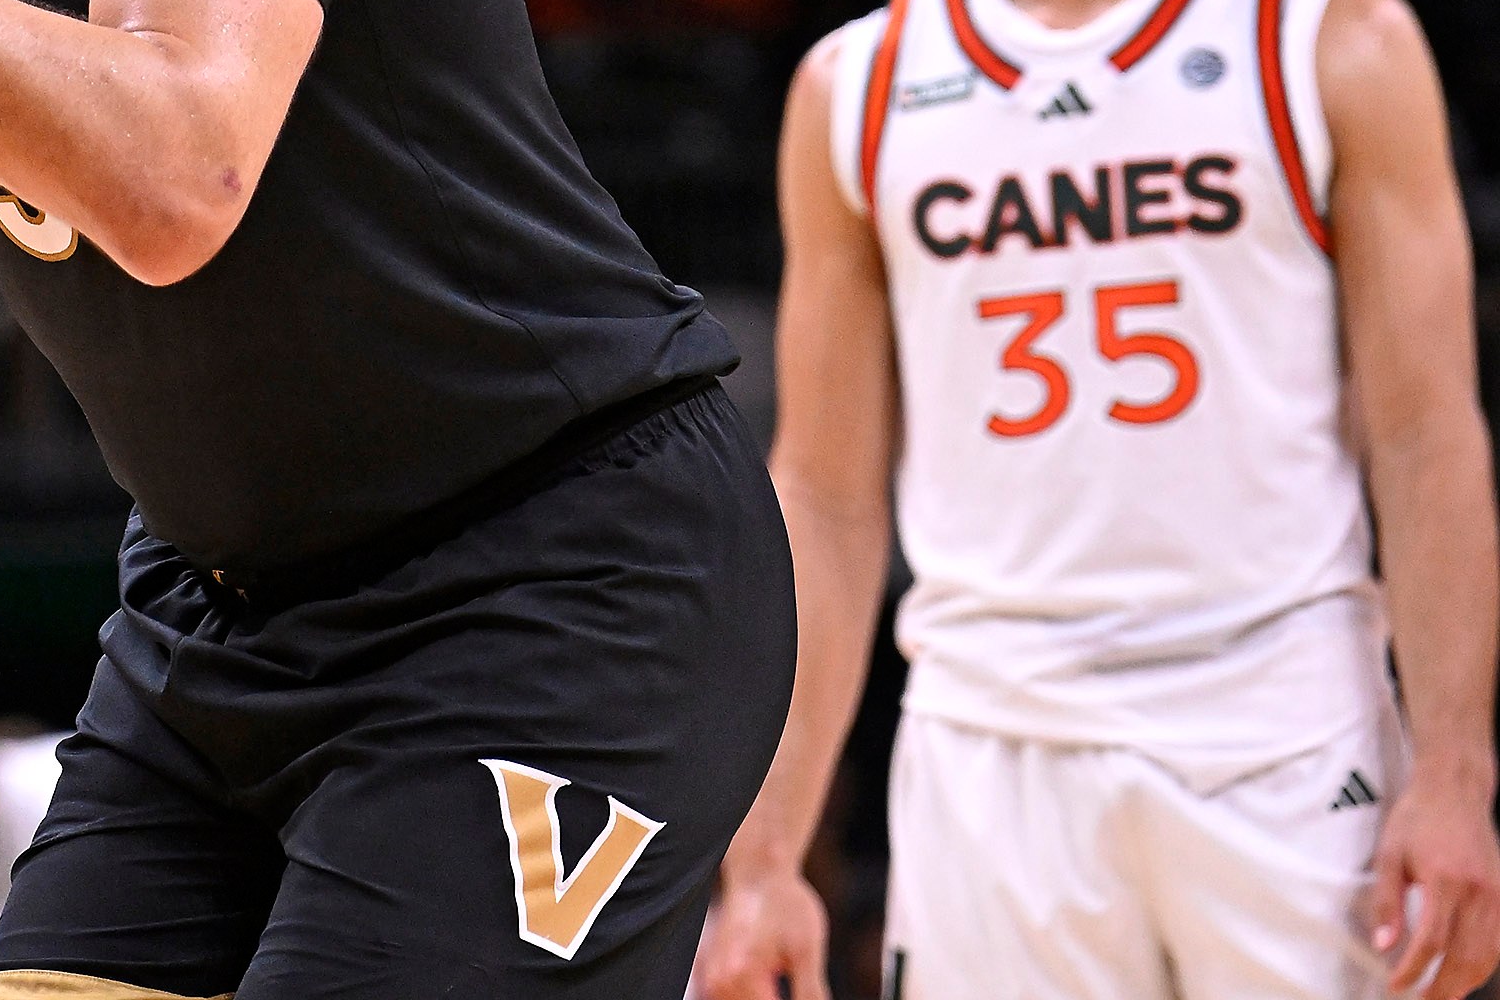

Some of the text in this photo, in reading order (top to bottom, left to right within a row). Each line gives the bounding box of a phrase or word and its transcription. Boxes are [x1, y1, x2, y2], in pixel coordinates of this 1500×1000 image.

[912, 155, 1245, 261] CANES
[978, 281, 1200, 438] 35
[478, 758, 668, 961] V
